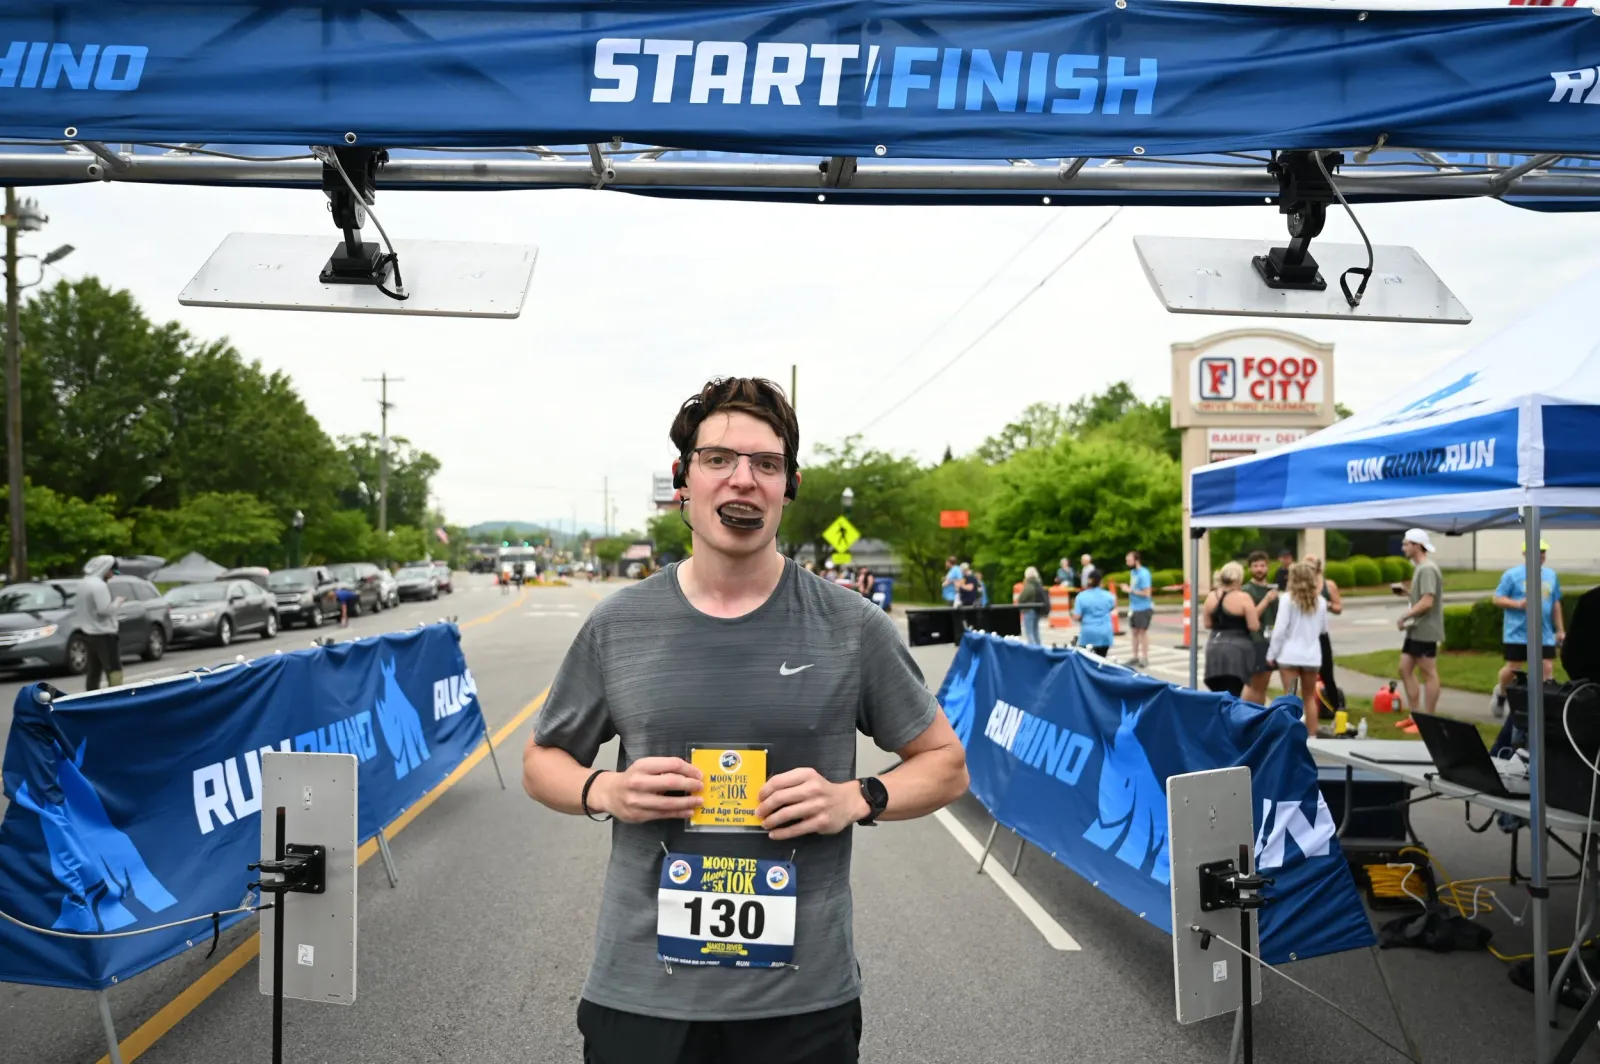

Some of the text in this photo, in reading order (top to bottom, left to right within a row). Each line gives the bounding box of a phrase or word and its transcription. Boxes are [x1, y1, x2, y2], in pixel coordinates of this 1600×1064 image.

[1243, 357, 1318, 379] FOOD
[1249, 379, 1310, 401] CITY
[1211, 432, 1261, 444] BAKERY
[710, 774, 748, 784] MOON PIE
[717, 808, 731, 816] Age
[734, 808, 756, 816] Group
[702, 856, 757, 872] MOON PIE
[712, 880, 725, 893] 5K
[684, 897, 765, 940] 130
[706, 942, 743, 952] NAKED RIVER
